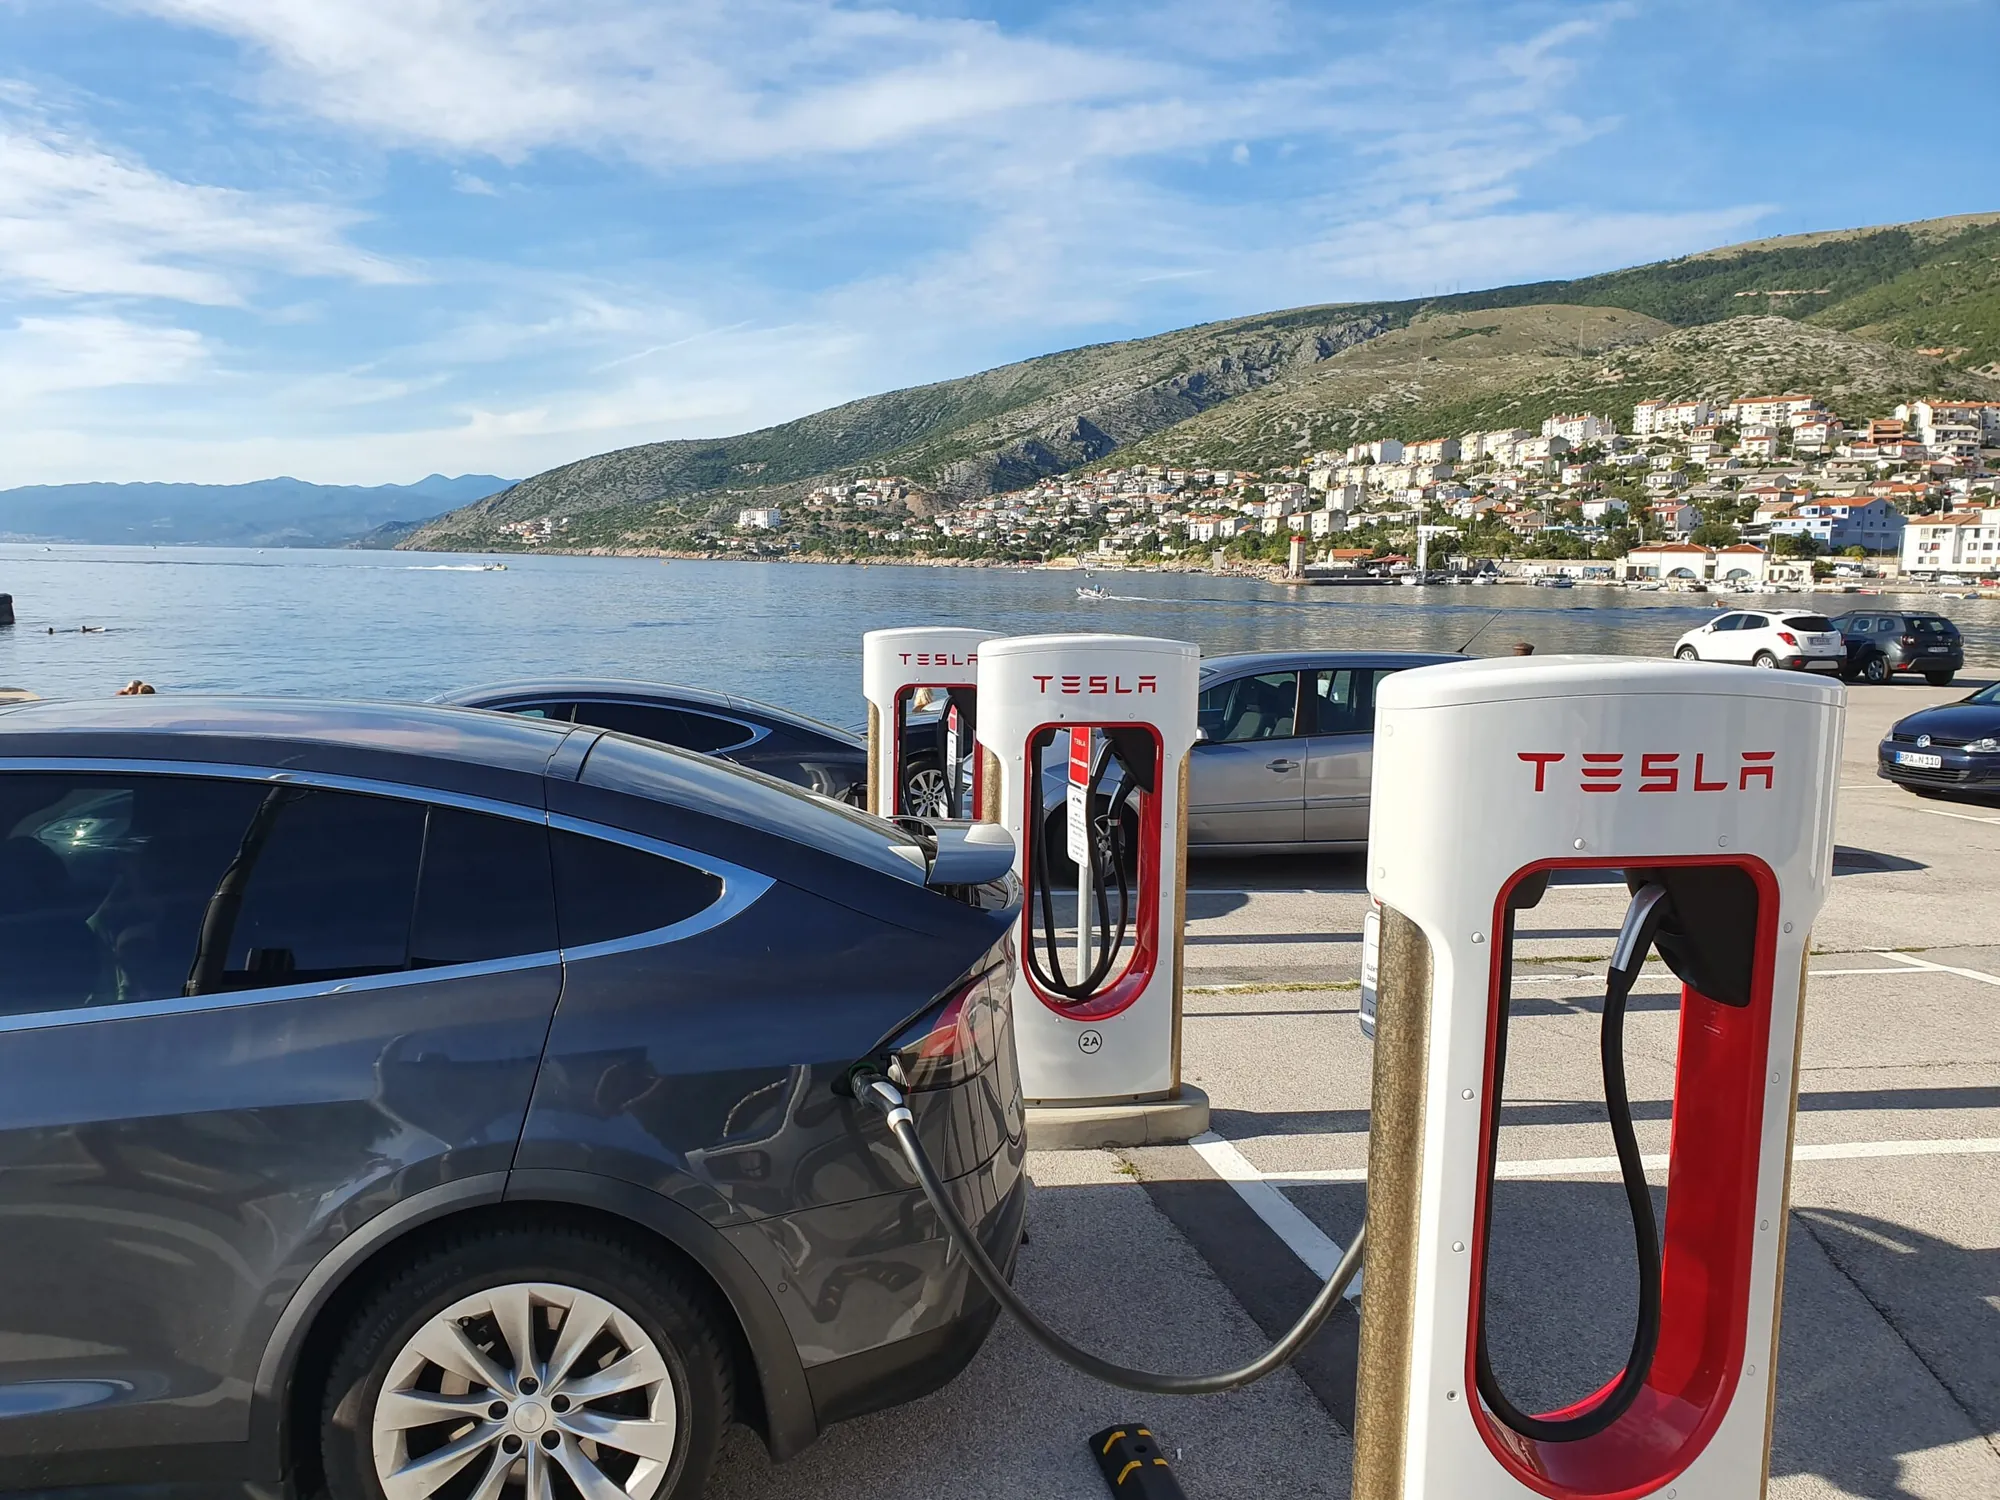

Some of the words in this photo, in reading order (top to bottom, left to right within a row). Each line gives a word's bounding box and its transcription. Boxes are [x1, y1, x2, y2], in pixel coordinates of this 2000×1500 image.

[898, 653, 978, 666] TESLA
[1032, 675, 1157, 694] TESLA
[1517, 751, 1776, 792] TESLA
[1082, 1036, 1099, 1047] 2A
